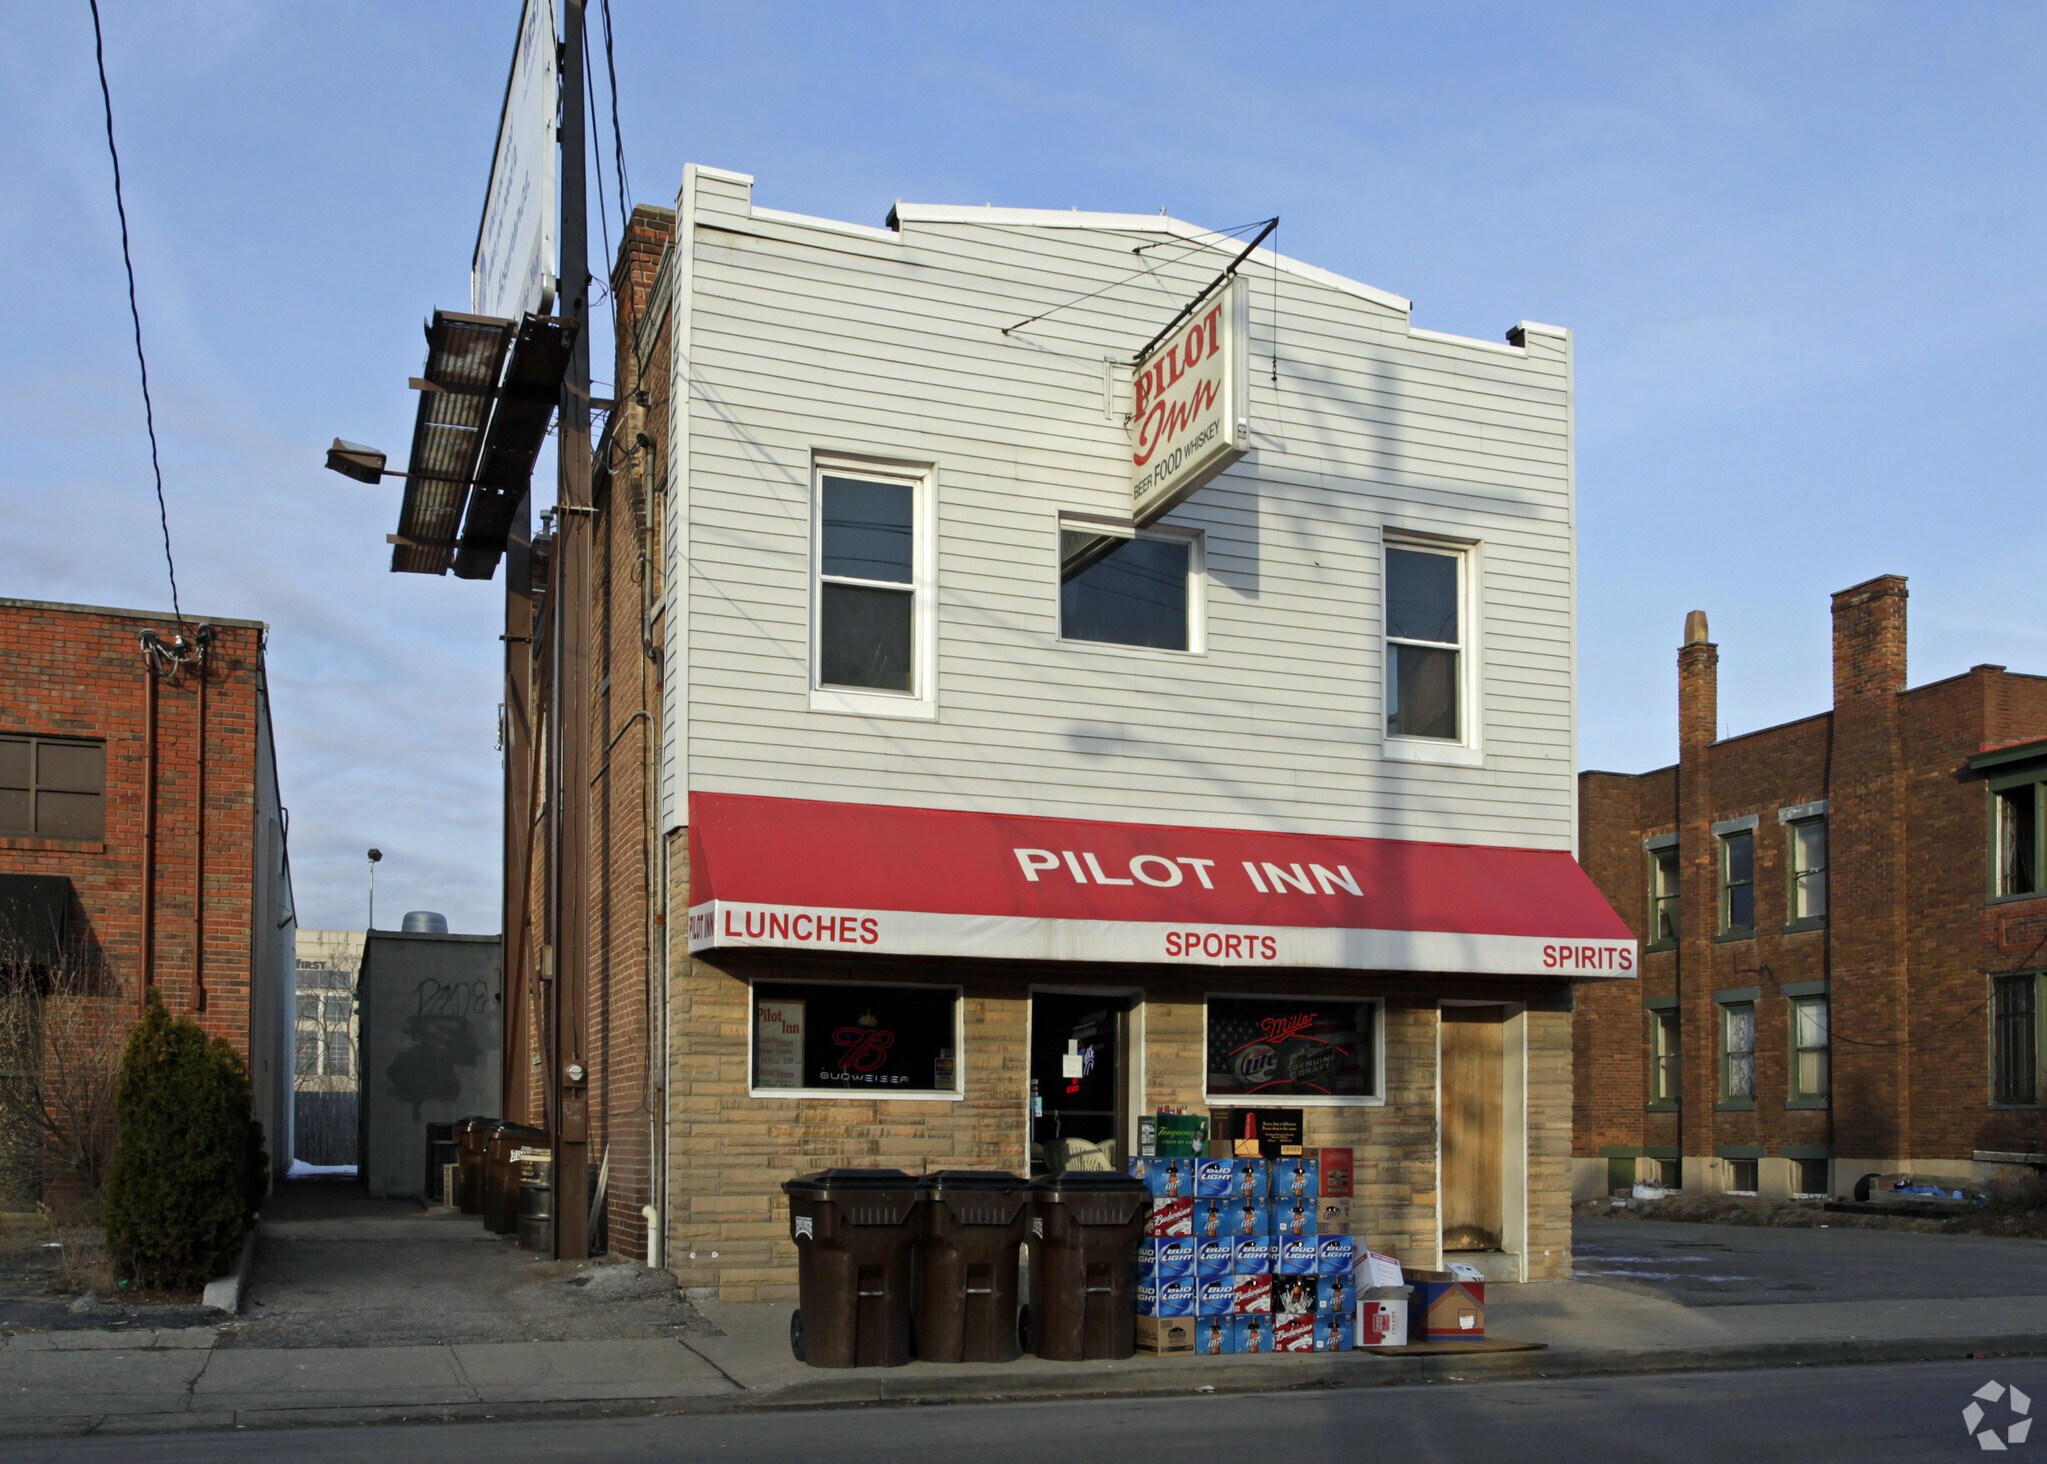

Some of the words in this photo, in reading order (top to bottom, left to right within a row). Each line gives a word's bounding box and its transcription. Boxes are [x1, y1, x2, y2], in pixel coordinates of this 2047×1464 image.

[1133, 302, 1222, 424] PILOT
[1133, 378, 1221, 467] Inn
[1134, 473, 1153, 500] BEER
[1154, 446, 1182, 487] FOOD
[1184, 418, 1221, 458] WHISKEY
[1012, 848, 1215, 890] PILOT
[1241, 861, 1365, 897] INN
[724, 910, 880, 945] LUNCHES
[1165, 931, 1277, 960] SPORTS
[1542, 944, 1633, 971] SPIRITS
[757, 1007, 783, 1023] Pilot
[782, 1019, 800, 1034] Inn
[1261, 1013, 1318, 1038] Miller
[820, 1071, 910, 1084] BUDWEISER
[1158, 1127, 1195, 1139] Tanqueray
[1154, 1207, 1191, 1226] Budweiser
[1162, 1292, 1194, 1300] LIGHT
[1202, 1292, 1235, 1300] LIGHT
[1234, 1284, 1272, 1302] Budweiser
[1274, 1323, 1313, 1342] Budweiser
